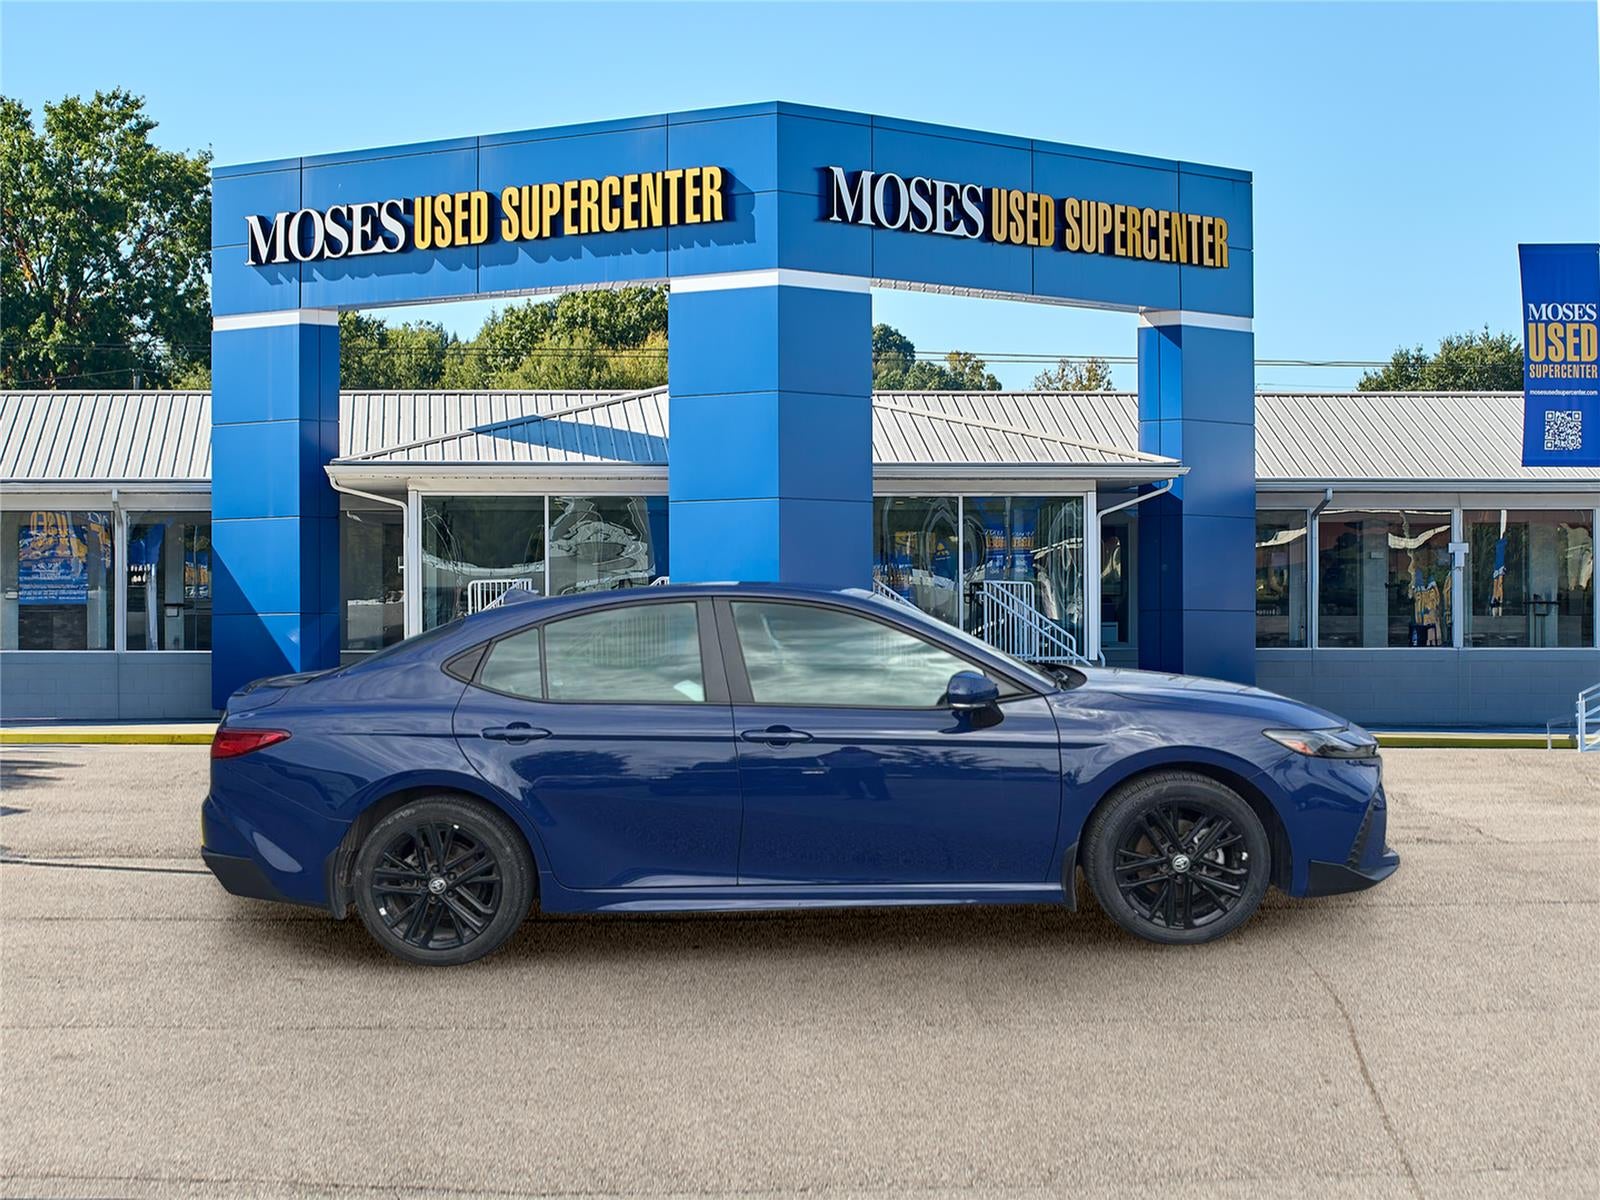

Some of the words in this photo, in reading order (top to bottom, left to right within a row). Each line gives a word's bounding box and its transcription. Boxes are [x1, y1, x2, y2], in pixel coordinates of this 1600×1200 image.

[245, 199, 407, 267] MOSES
[413, 191, 489, 250] USED
[501, 166, 724, 242] SUPERCENTER
[828, 166, 985, 239] MOSES
[991, 187, 1055, 247] USED
[1065, 197, 1229, 268] SUPERCENTER
[1528, 303, 1597, 321] MOSES
[1528, 322, 1598, 362] USED
[1529, 364, 1598, 379] SUPERCENTER
